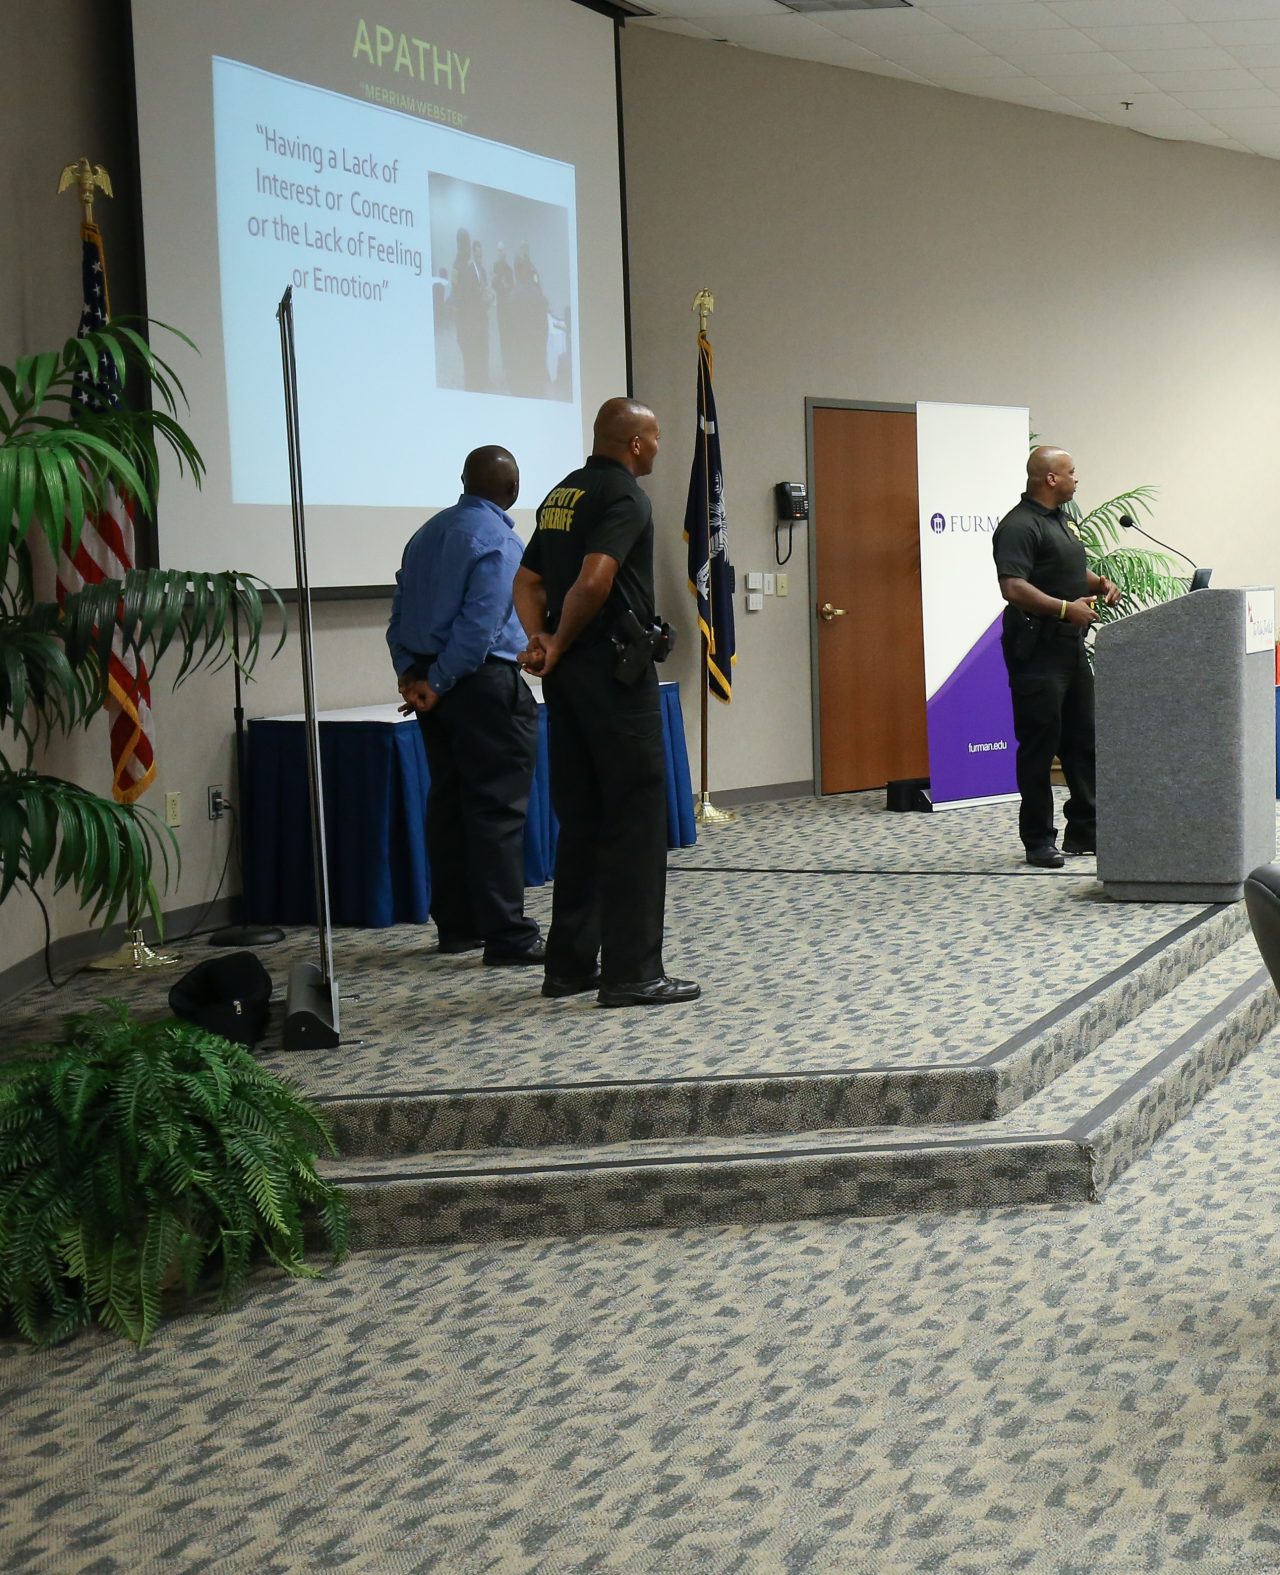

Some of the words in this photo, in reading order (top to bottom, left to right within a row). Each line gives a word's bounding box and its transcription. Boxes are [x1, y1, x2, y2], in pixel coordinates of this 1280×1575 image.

[352, 18, 470, 95] APATHY
[256, 123, 323, 174] "Having
[328, 149, 337, 169] a
[342, 147, 379, 180] Lack
[382, 158, 398, 184] of
[256, 167, 321, 208] Interest
[325, 191, 343, 211] or
[350, 191, 414, 228] Concern
[248, 216, 269, 238] or
[272, 213, 300, 245] the
[304, 221, 343, 253] Lack
[347, 231, 364, 257] of
[368, 235, 422, 276] Feeling
[292, 268, 309, 289] or
[313, 266, 389, 302] Emotion"
[539, 507, 575, 532] SHERIFF
[951, 515, 1000, 533] FURM
[968, 739, 1008, 753] furman.edu
